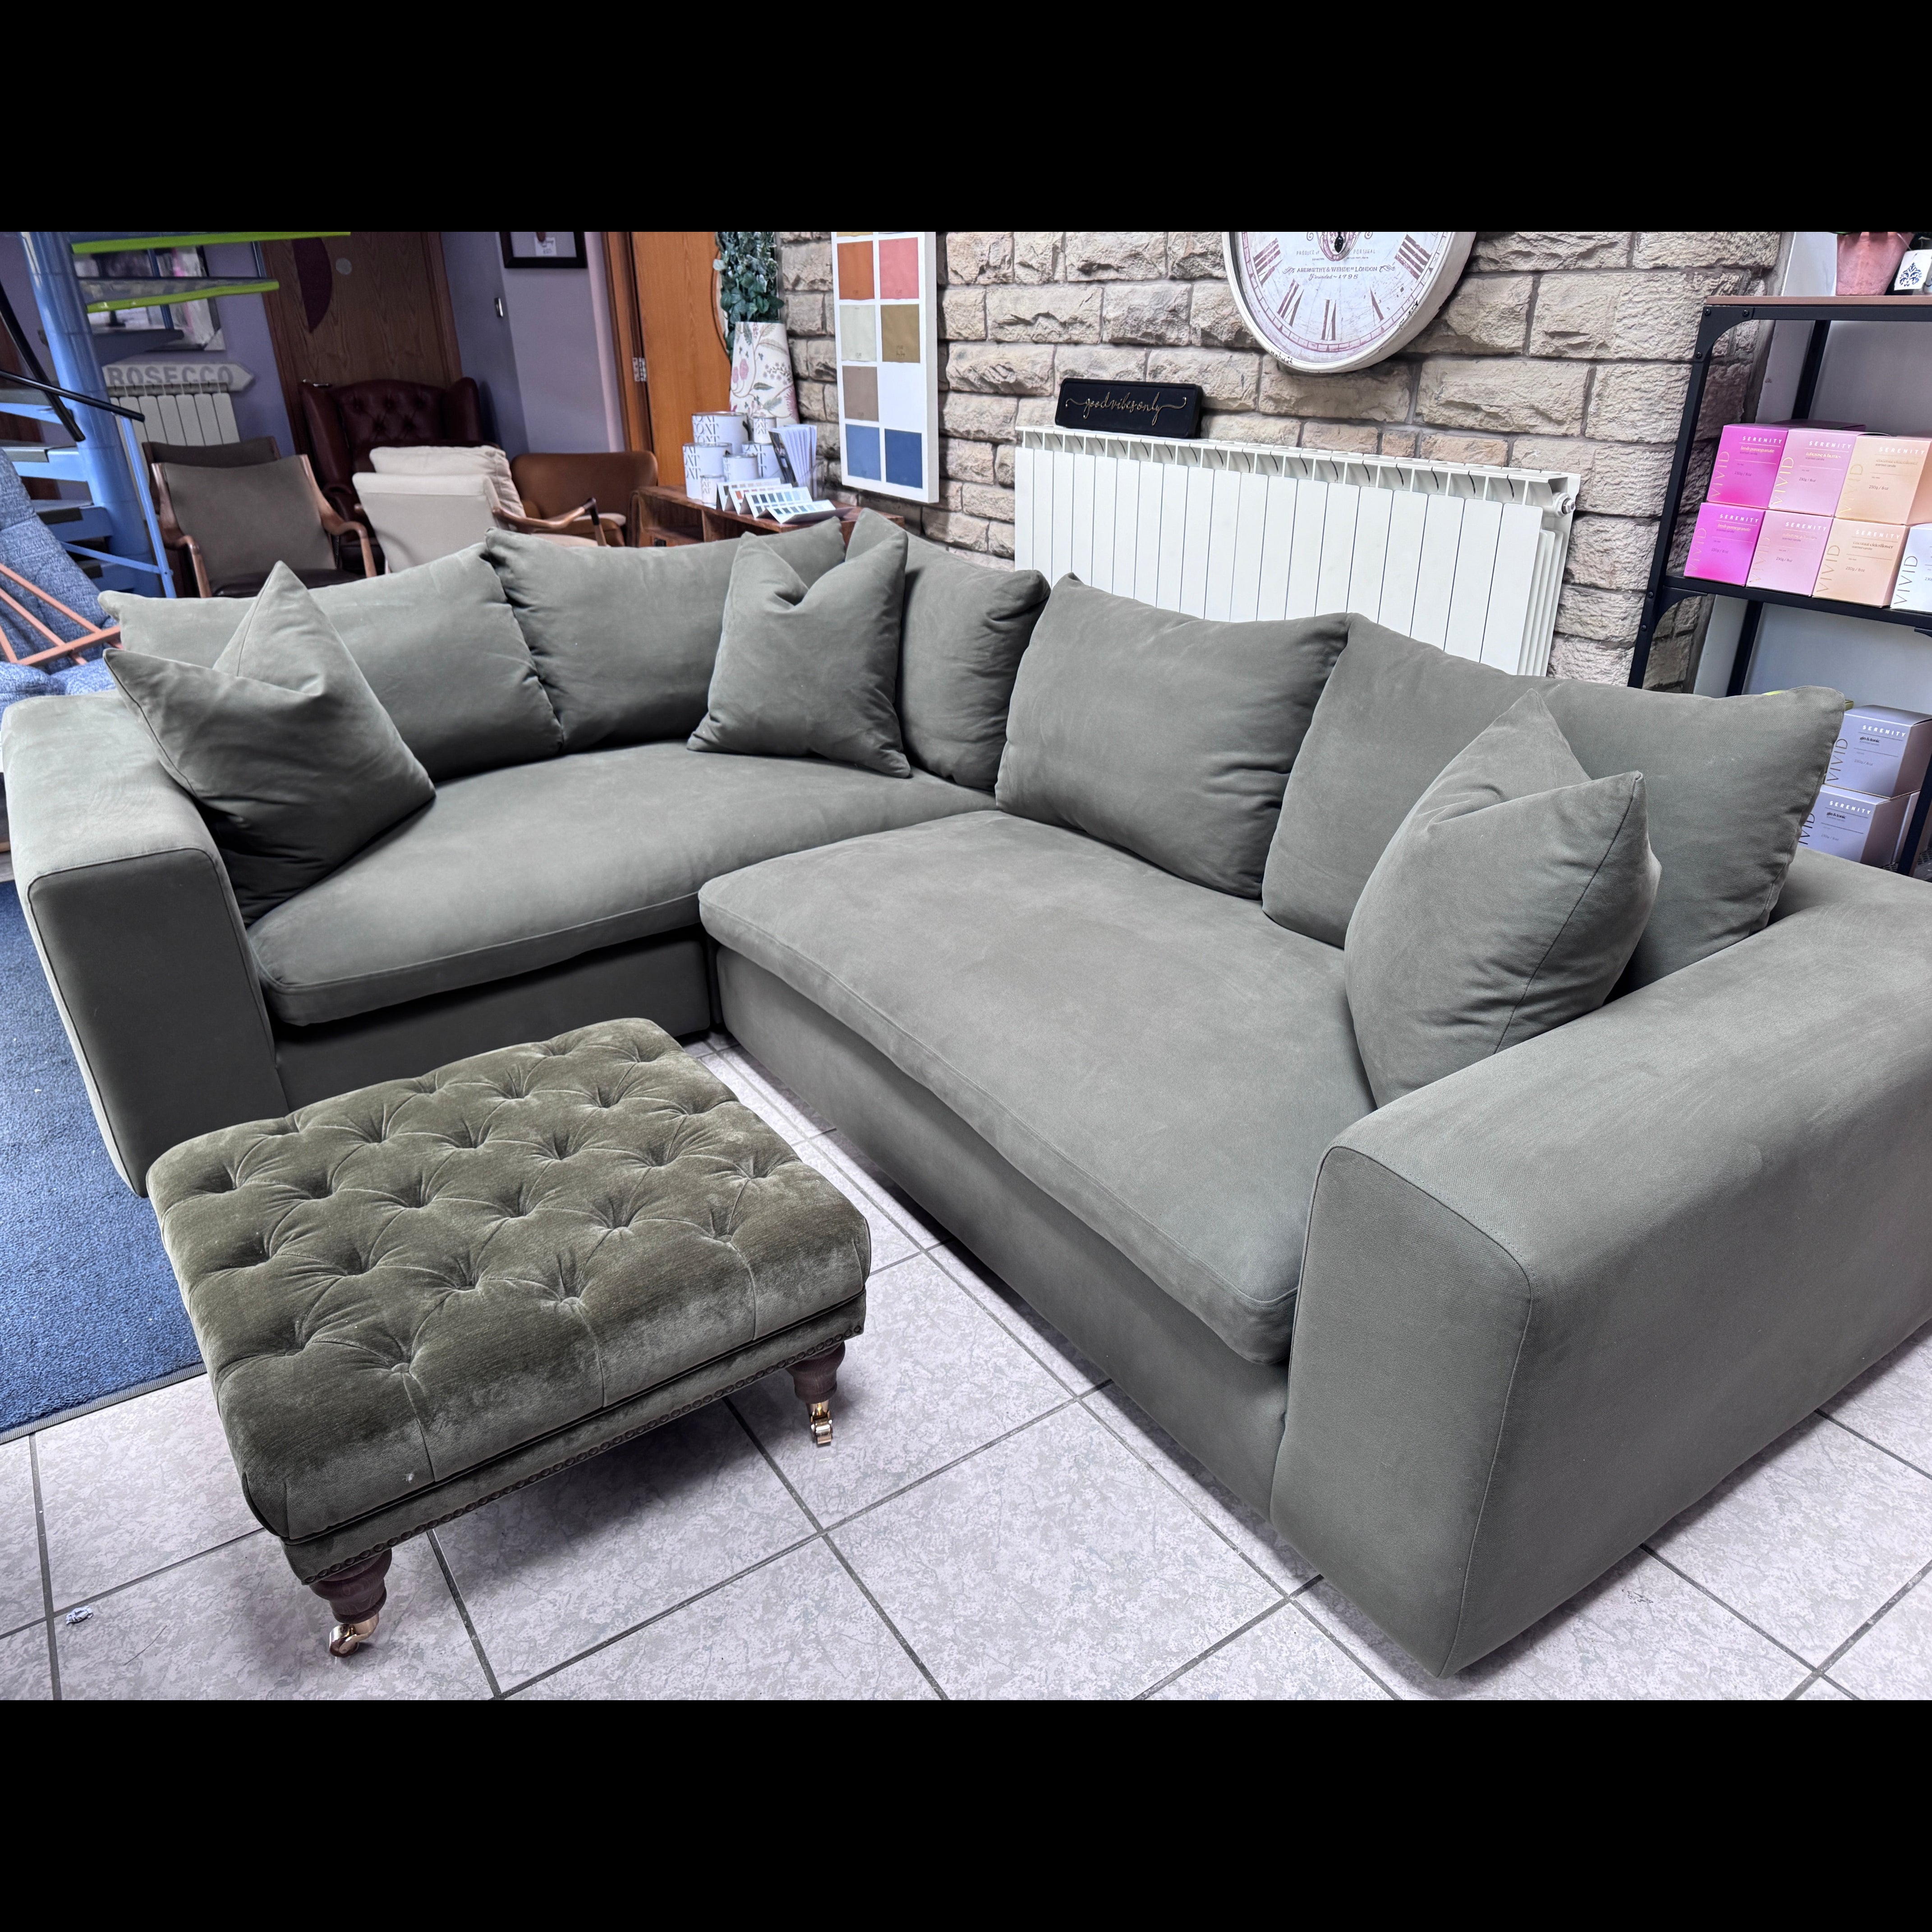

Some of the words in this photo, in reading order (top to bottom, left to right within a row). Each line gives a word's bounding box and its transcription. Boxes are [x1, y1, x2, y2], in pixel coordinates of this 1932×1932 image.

[1711, 451, 1730, 497] VIVID
[1772, 457, 1794, 505] VIVID
[1839, 464, 1863, 513] VIVID
[1720, 514, 1758, 523] SERENITY
[1785, 522, 1826, 531] SERENITY
[1855, 530, 1900, 539] SERENITY
[1688, 528, 1707, 571] VIVID
[1750, 537, 1771, 582] VIVID
[1817, 545, 1840, 592] VIVID
[1894, 556, 1918, 604] VIVID
[1863, 725, 1906, 737] SERENITY
[1827, 739, 1848, 781] VIVID
[1829, 800, 1871, 814] SERENITY
